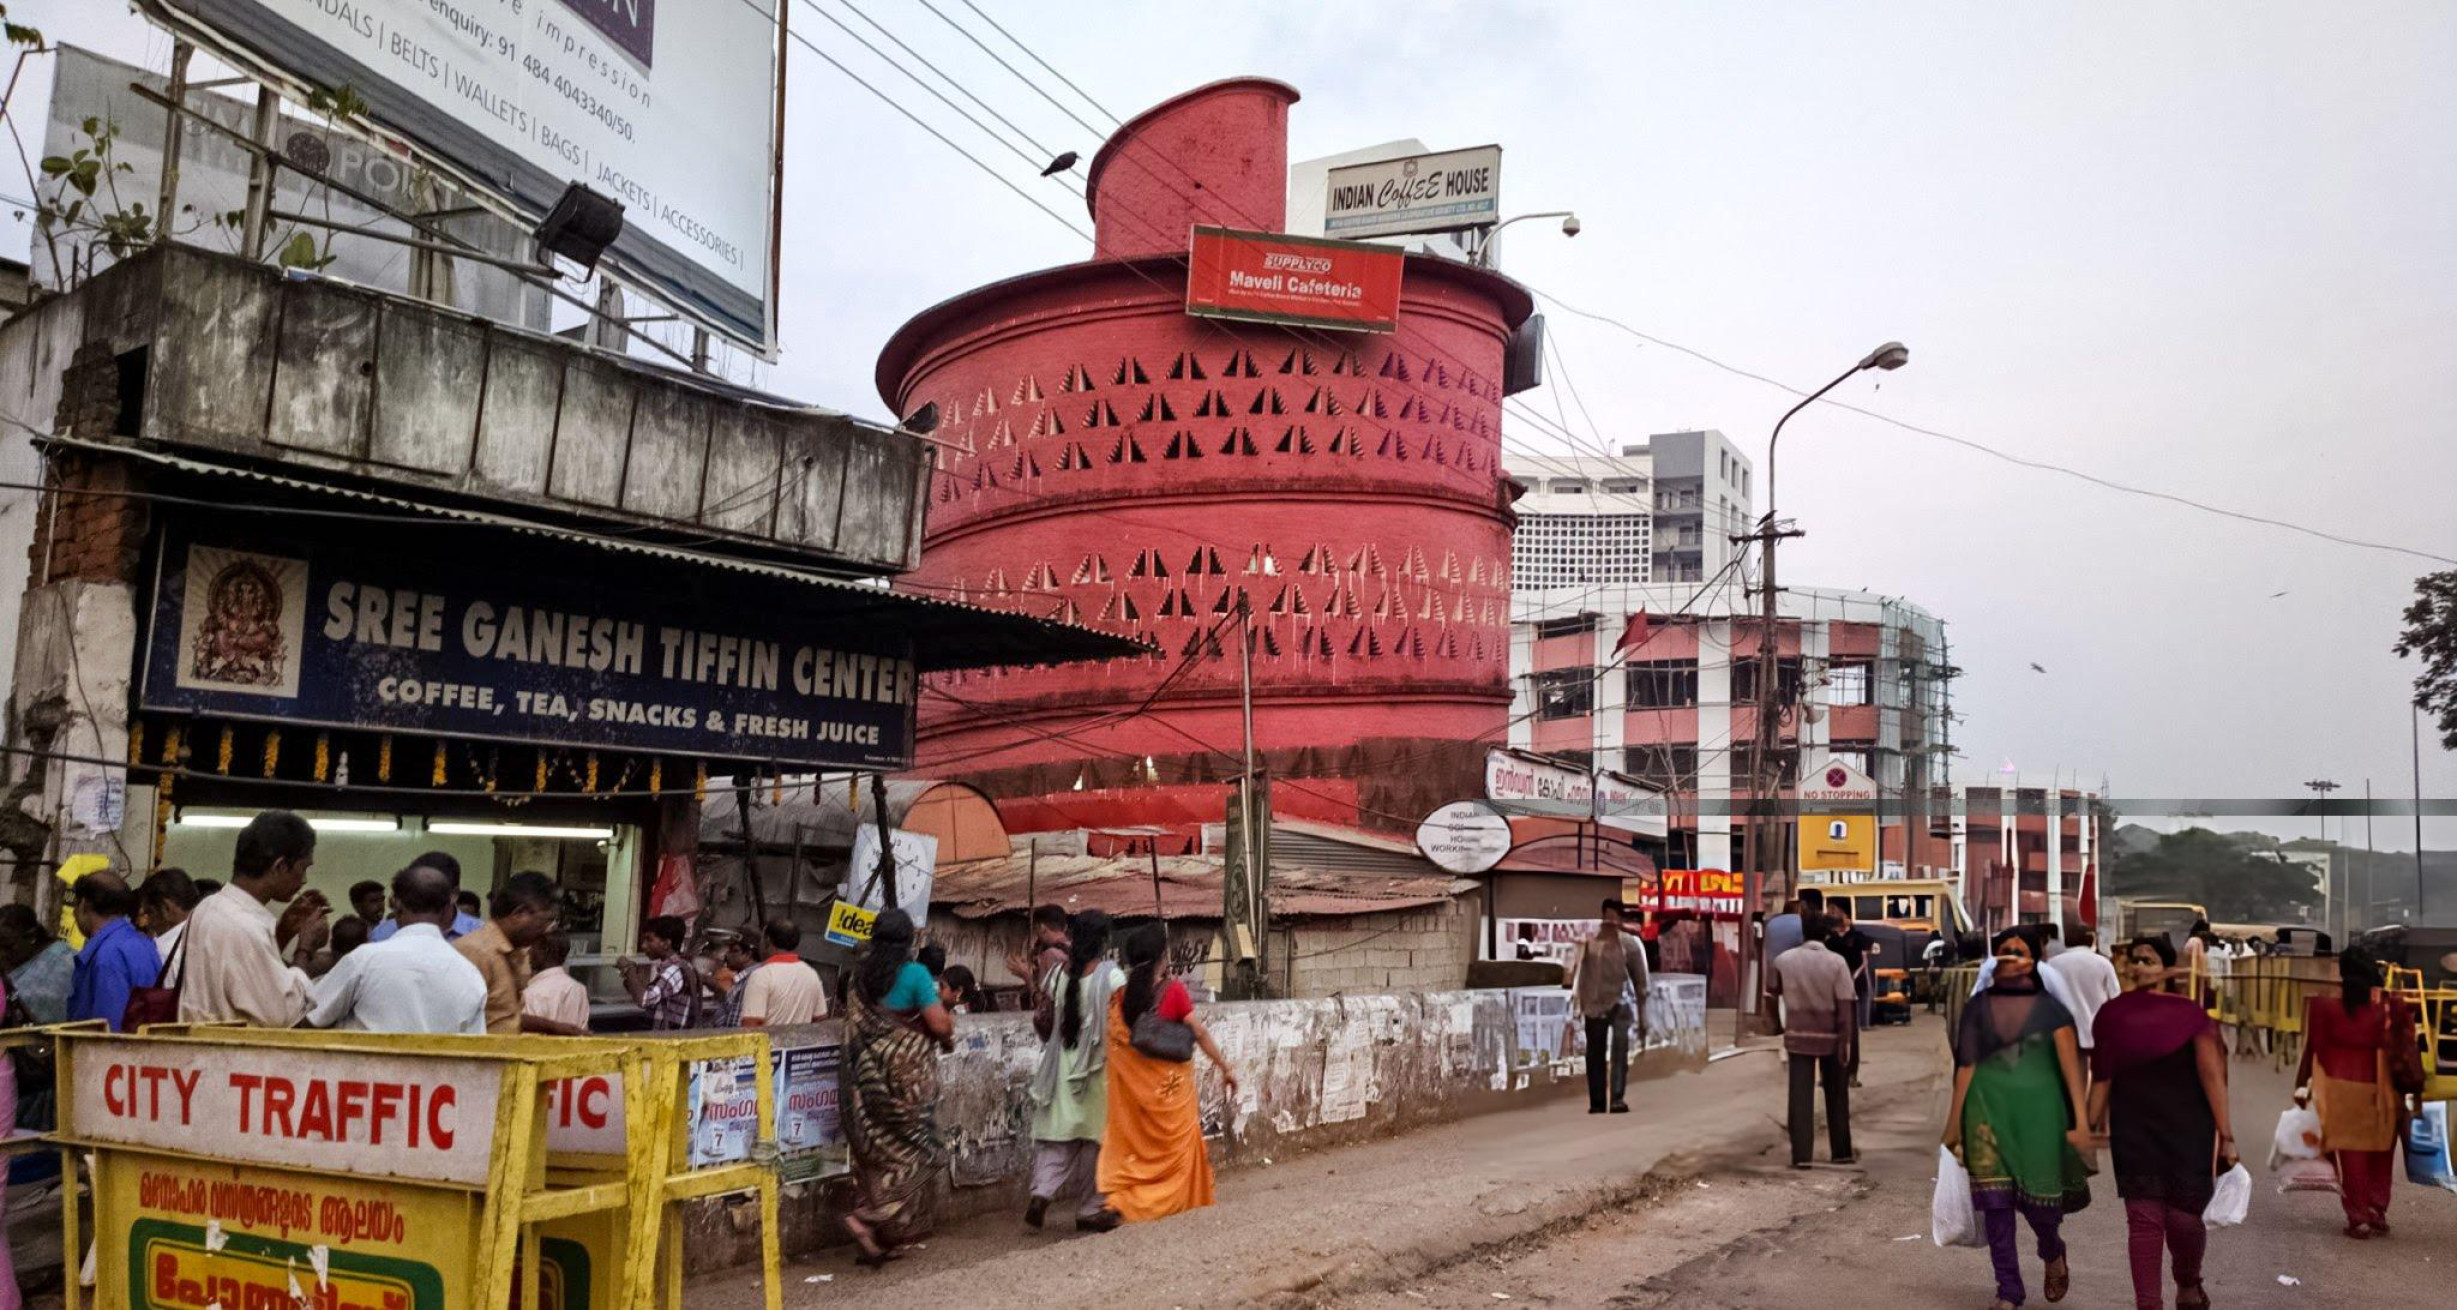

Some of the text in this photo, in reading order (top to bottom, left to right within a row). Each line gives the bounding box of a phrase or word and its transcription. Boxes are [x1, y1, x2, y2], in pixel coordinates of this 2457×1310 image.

[430, 0, 493, 48] enquiry:
[498, 36, 516, 62] 91
[522, 54, 551, 85] 484
[536, 10, 651, 108] impression
[391, 32, 438, 79] BELTS
[455, 69, 528, 133] WALLETS
[541, 125, 580, 167] BAGS
[596, 161, 650, 211] JACKETS
[661, 204, 738, 265] ACCESSORIES
[1332, 184, 1375, 212] INDIAN
[1446, 167, 1489, 197] HOUSE
[1230, 270, 1282, 291] Maveli
[1287, 276, 1363, 299] Cafeteria
[1264, 254, 1332, 273] SUPPLYCO
[324, 581, 914, 704] SREE GANESH TIFFIN CENTER
[378, 675, 880, 745] COFFEE, TEA, SNACKS & FRESH JUICE
[1804, 790, 1870, 799] NO STOPPING
[103, 1063, 456, 1150] CITY TRAFFIC
[793, 1123, 802, 1136] 7
[714, 1133, 723, 1147] 7
[320, 1194, 405, 1244] ആലയം
